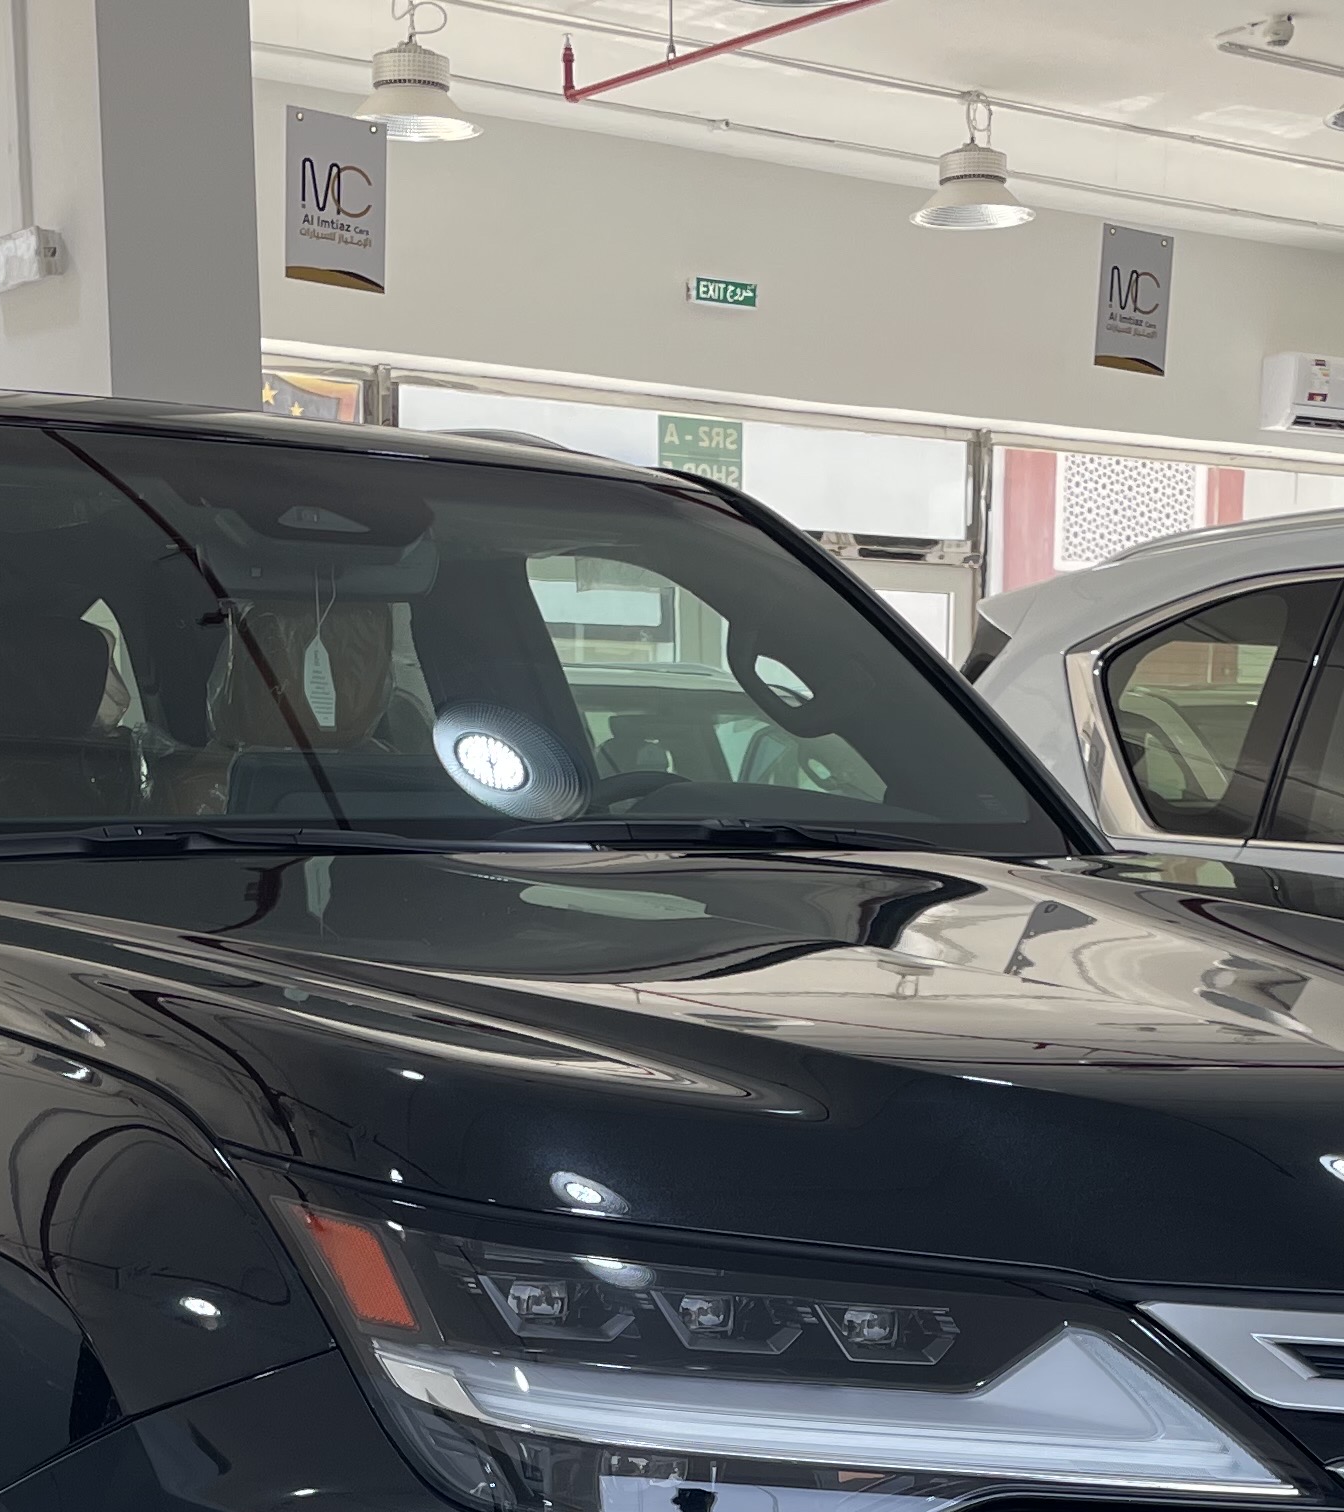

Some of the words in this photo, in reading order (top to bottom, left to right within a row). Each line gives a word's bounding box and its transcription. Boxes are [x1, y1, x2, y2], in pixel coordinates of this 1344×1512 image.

[302, 213, 314, 226] Al
[316, 215, 351, 232] Imtiaz
[699, 281, 726, 300] EXIT
